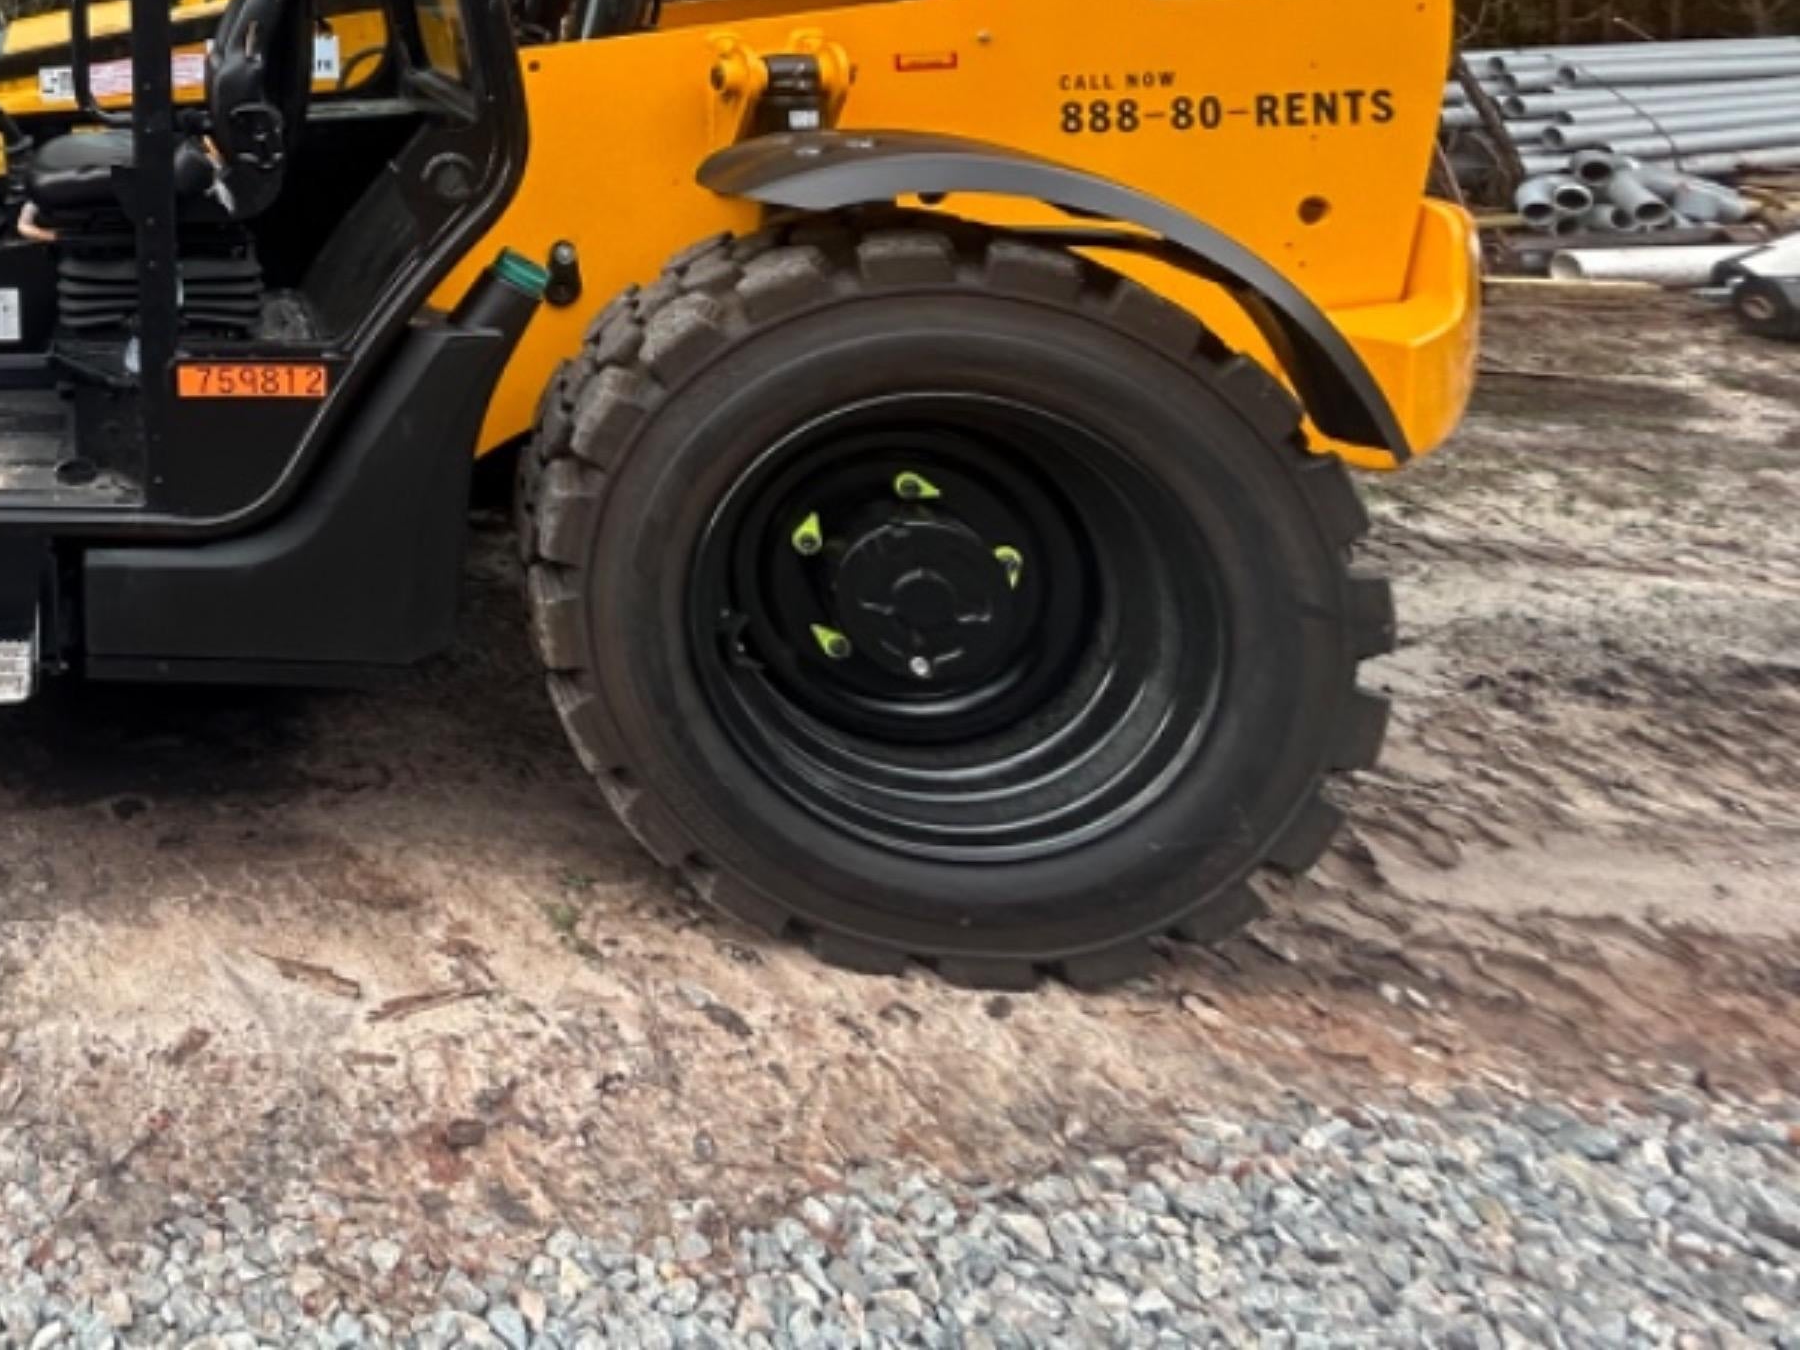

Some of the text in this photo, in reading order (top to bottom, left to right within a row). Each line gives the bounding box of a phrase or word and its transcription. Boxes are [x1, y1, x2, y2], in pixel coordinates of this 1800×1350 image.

[1058, 71, 1176, 91] CALL NOW
[1060, 89, 1396, 134] 888-80-RENTS
[196, 366, 323, 395] 759812
